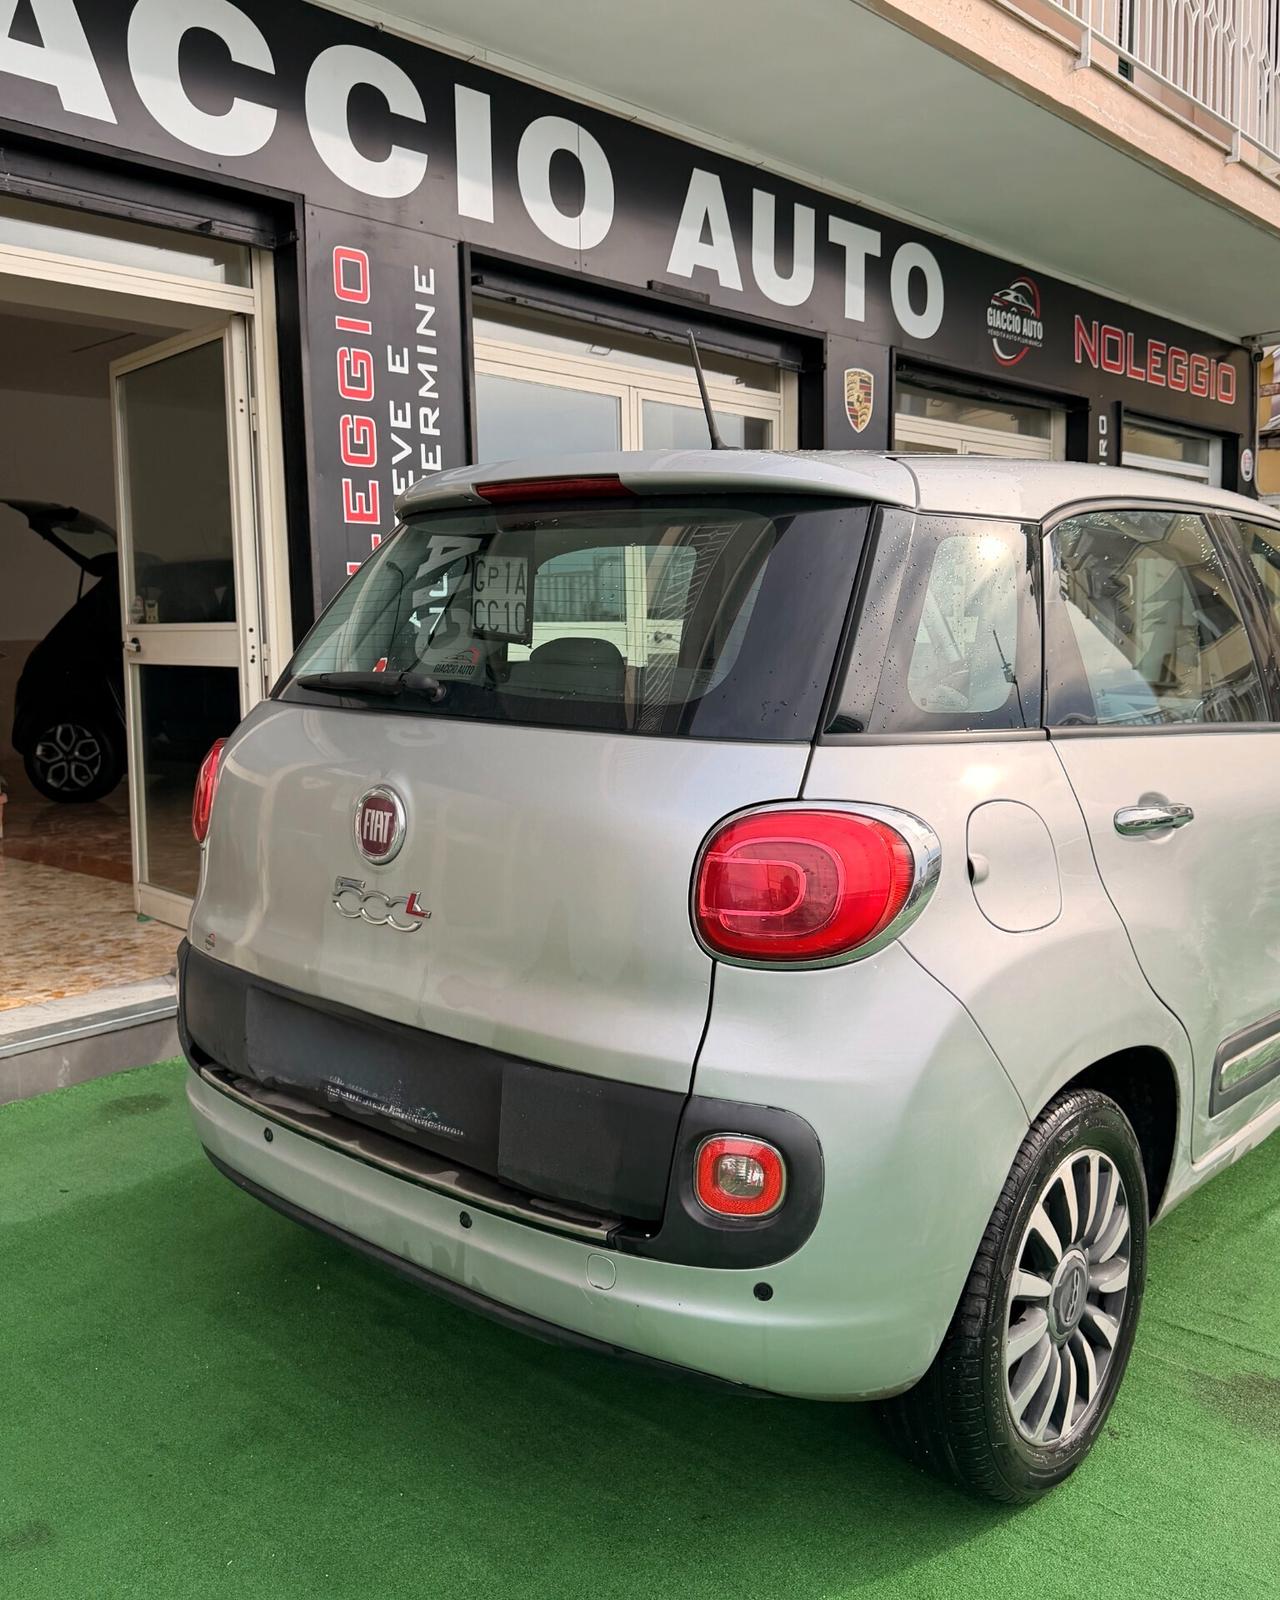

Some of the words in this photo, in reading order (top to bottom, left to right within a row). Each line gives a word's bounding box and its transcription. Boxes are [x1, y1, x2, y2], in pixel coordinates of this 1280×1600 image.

[666, 167, 944, 340] AUTO
[987, 307, 1021, 333] GIACCIO
[1022, 318, 1043, 340] AUTO
[387, 344, 409, 374] E
[414, 264, 442, 479] ERMINE
[1074, 314, 1236, 405] NOLEGGIO
[389, 399, 414, 527] EVE
[1099, 415, 1108, 466] RO
[363, 808, 394, 843] FIAT
[332, 876, 432, 933] 500L
